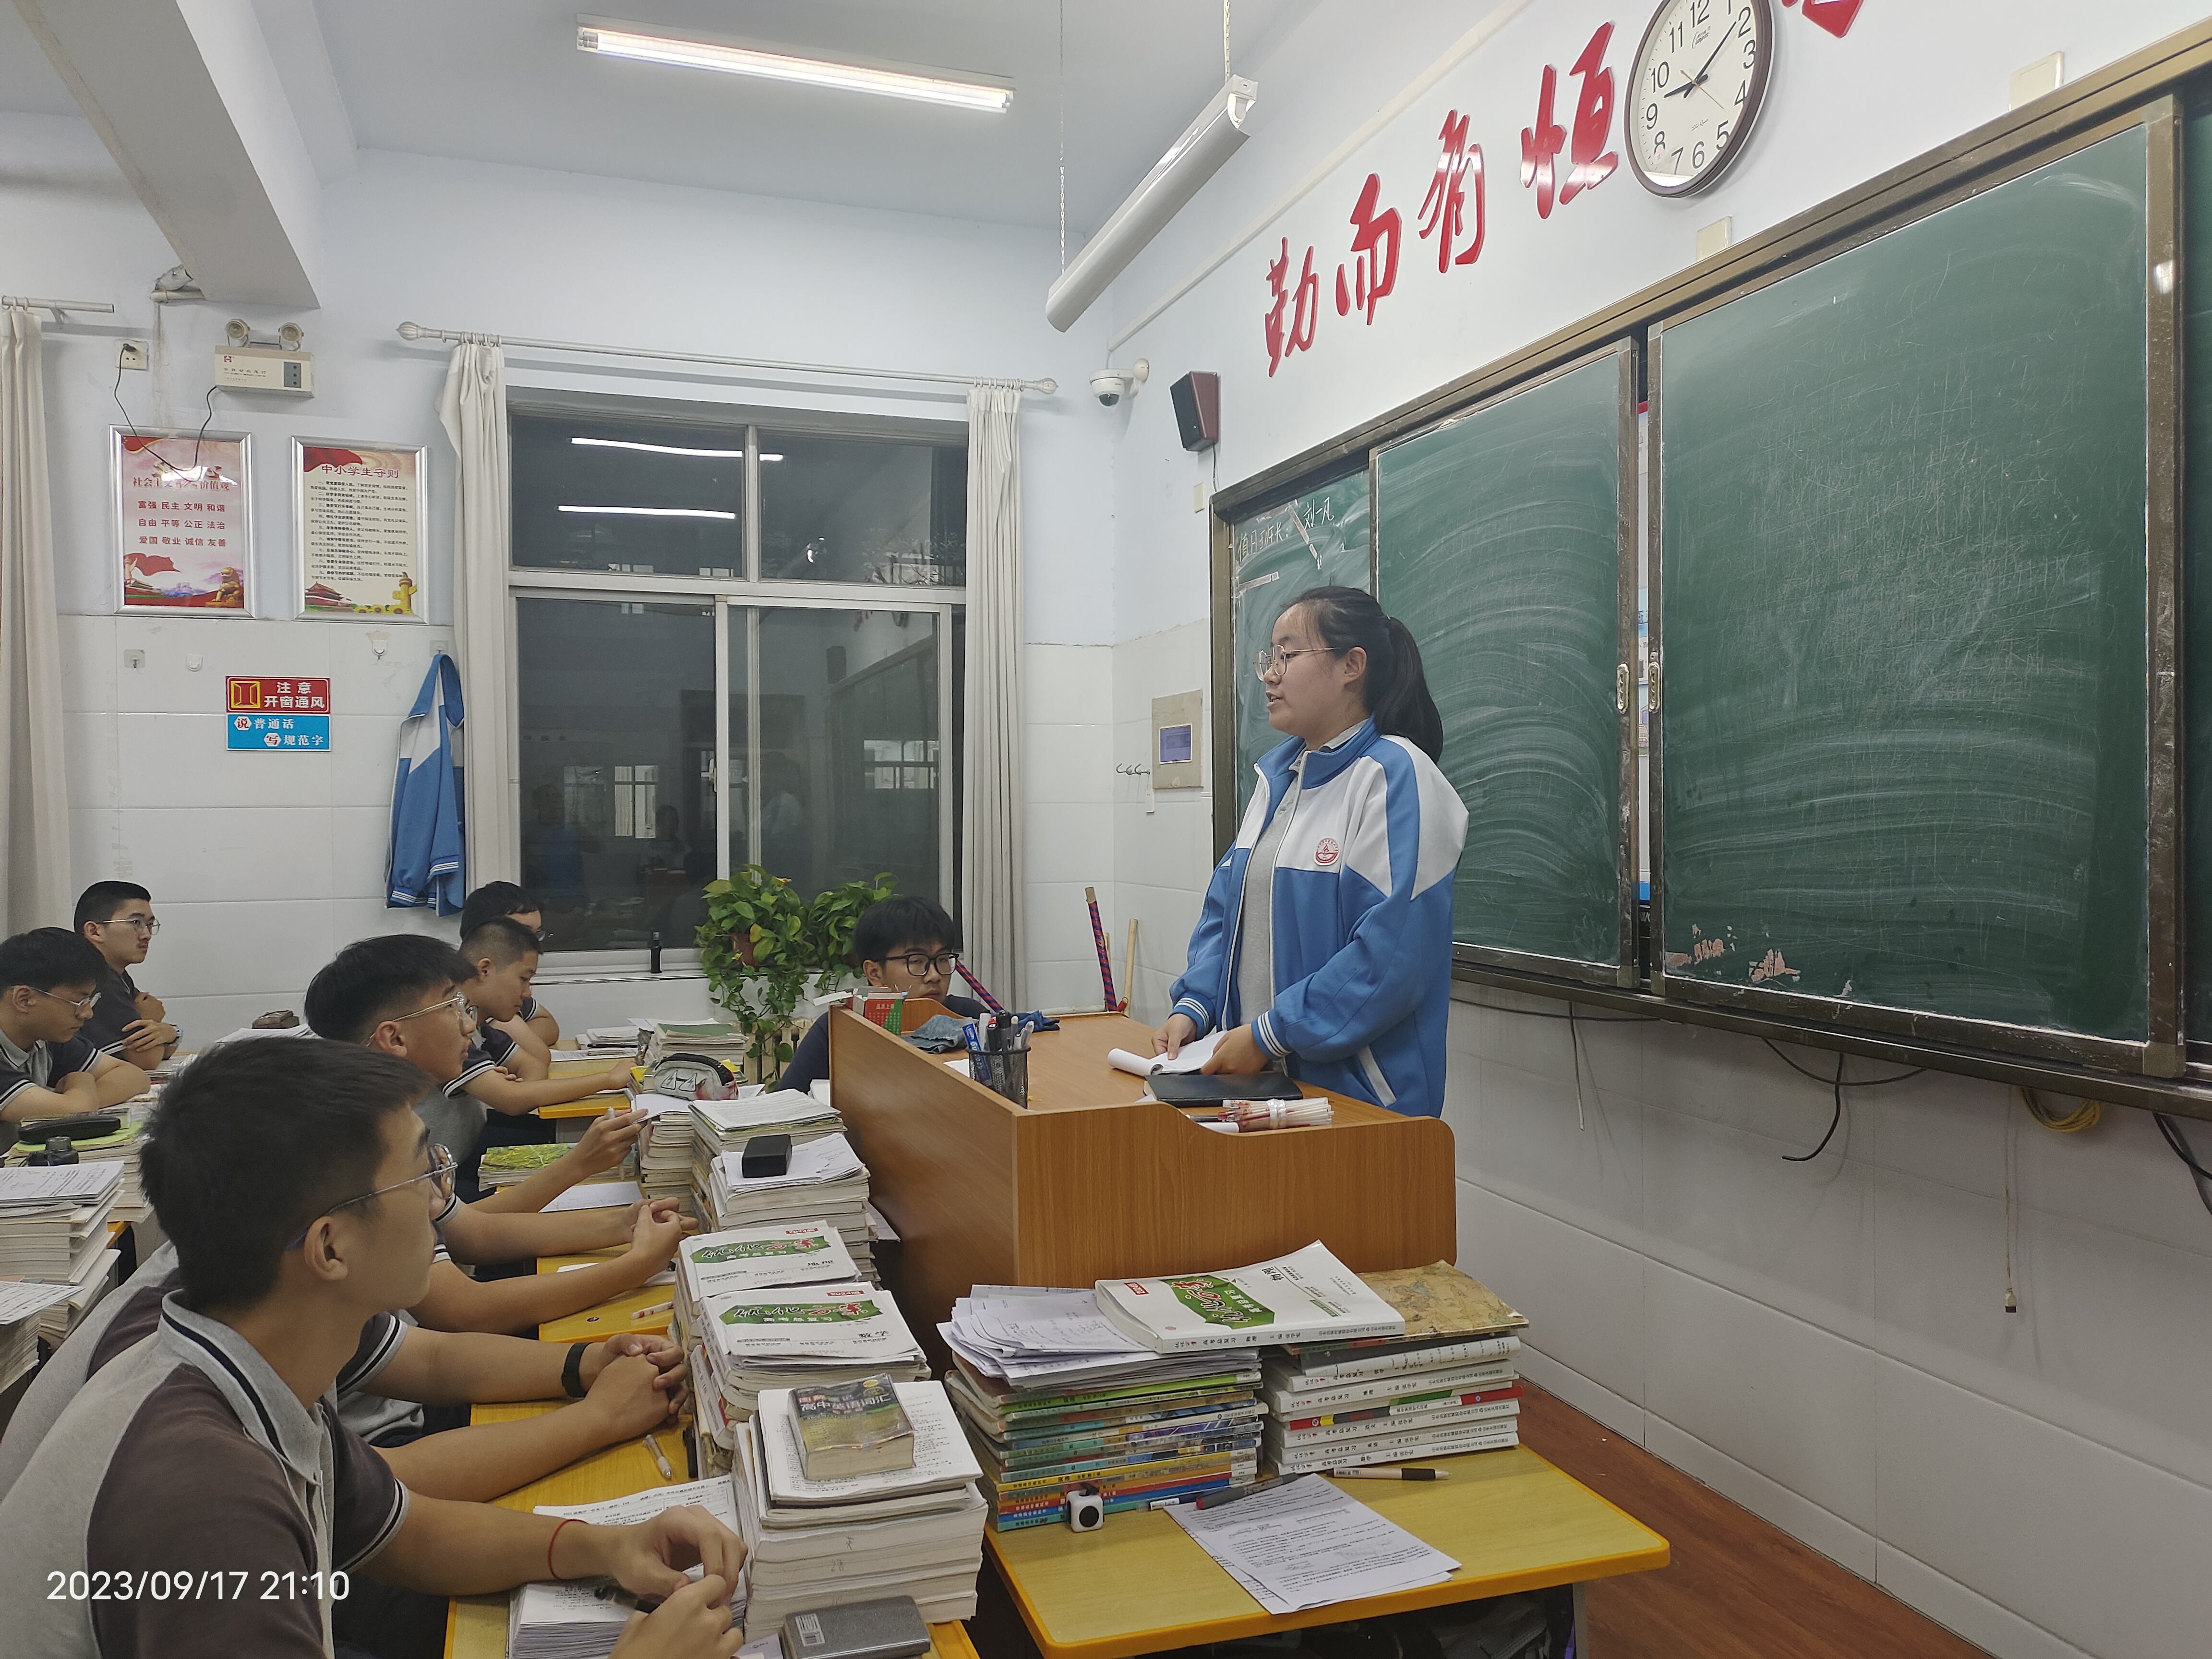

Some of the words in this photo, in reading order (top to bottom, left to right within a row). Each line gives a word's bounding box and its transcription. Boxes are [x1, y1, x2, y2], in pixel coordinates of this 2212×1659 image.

[1690, 0, 1709, 28] 12
[1738, 6, 1751, 38] 2
[1669, 21, 1683, 53] 11
[1743, 39, 1755, 69] 3
[1651, 61, 1669, 93] 10
[1734, 80, 1746, 106] 4
[1647, 103, 1658, 130] 9
[1716, 120, 1728, 150] 5
[1671, 147, 1683, 175] 7
[1692, 141, 1704, 168] 6
[322, 465, 398, 479] 中小学生守则
[138, 501, 157, 509] 富强
[161, 502, 180, 510] 民主
[184, 503, 202, 511] 文明
[207, 504, 225, 512] 和谐
[1303, 496, 1334, 529] 刘一凡
[138, 518, 156, 527] 自由
[161, 519, 180, 527] 平等
[184, 520, 203, 529] 公正
[207, 521, 225, 529] 法治
[139, 536, 157, 544] 爱国
[162, 537, 180, 545] 敬业
[185, 538, 203, 546] 诚信
[208, 539, 226, 547] 友善
[276, 681, 312, 694] 注意
[264, 696, 325, 709] 开窗通风
[237, 718, 294, 729] 说普通话
[266, 734, 324, 746] 写规范字
